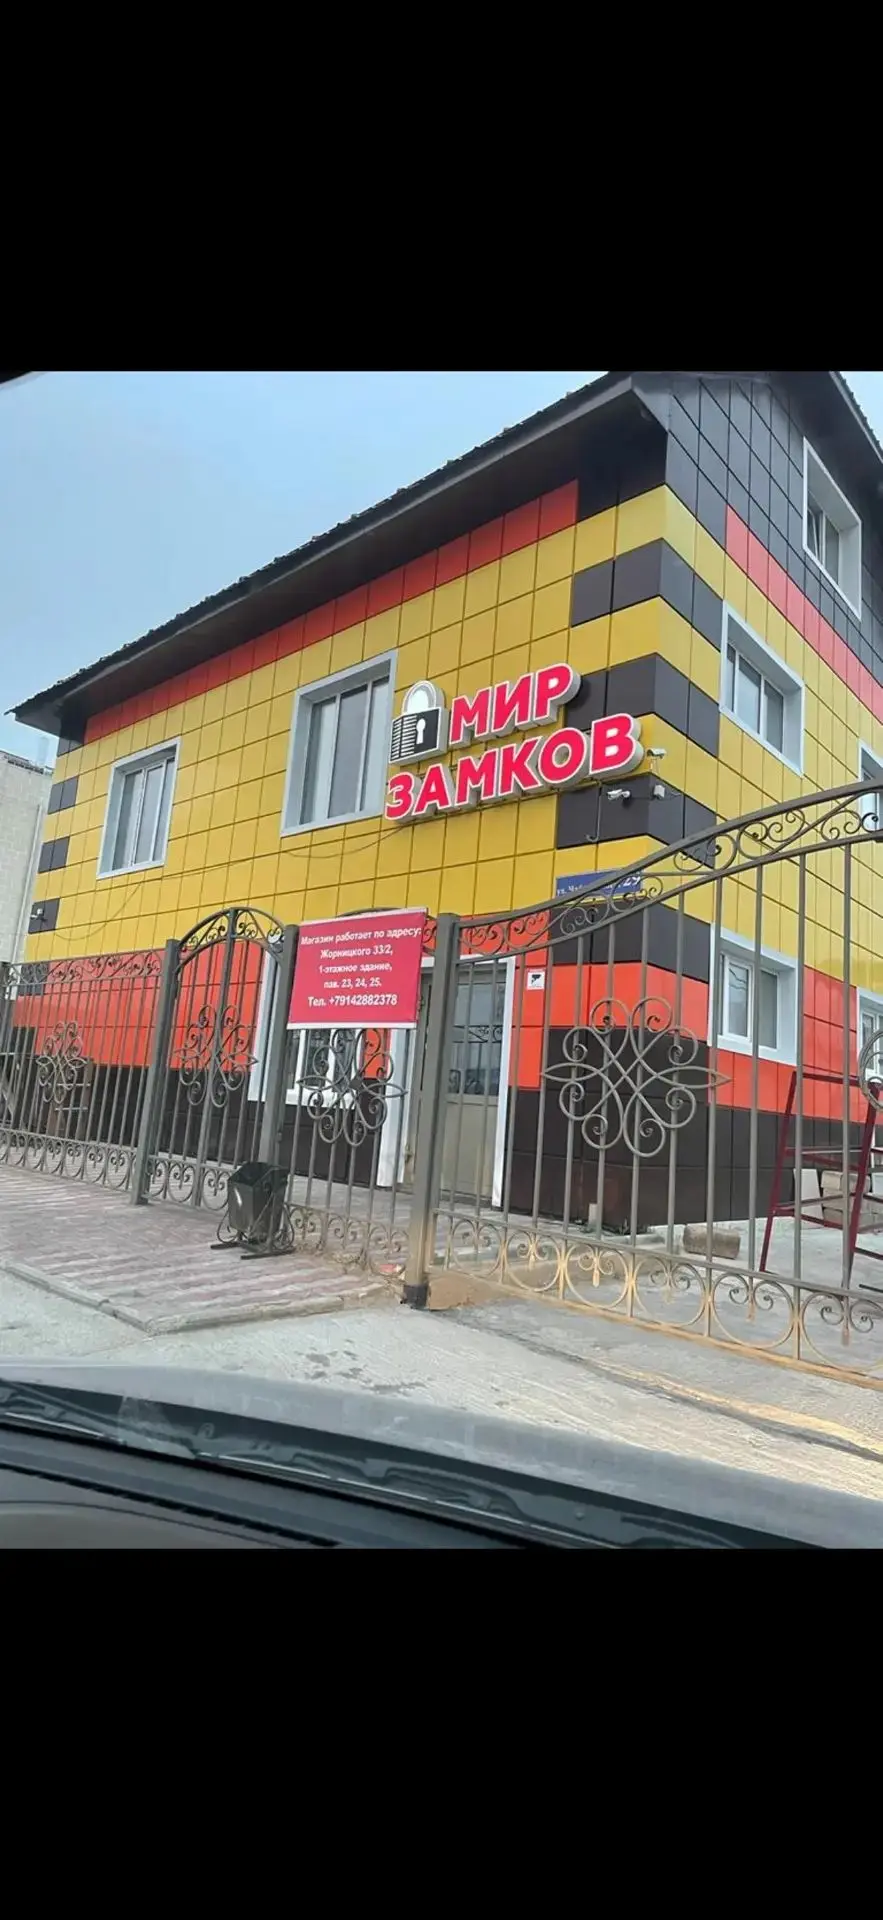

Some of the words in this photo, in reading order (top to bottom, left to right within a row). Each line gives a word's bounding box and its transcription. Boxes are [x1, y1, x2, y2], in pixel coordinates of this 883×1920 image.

[450, 663, 574, 745] МИР
[385, 713, 637, 821] ЗАМКОВ
[300, 935, 334, 945] Магазин
[335, 930, 372, 943] работает
[373, 931, 385, 939] по
[386, 926, 422, 939] адресу:
[320, 948, 371, 960] Жорницкого
[318, 965, 358, 974] 1-этажное
[359, 962, 393, 974] здание,
[323, 980, 340, 989] пав.
[341, 978, 353, 989] 23,
[355, 978, 368, 988] 24,
[369, 977, 382, 988] 25.
[307, 996, 327, 1007] Тел.
[329, 994, 398, 1006] +79142882378
